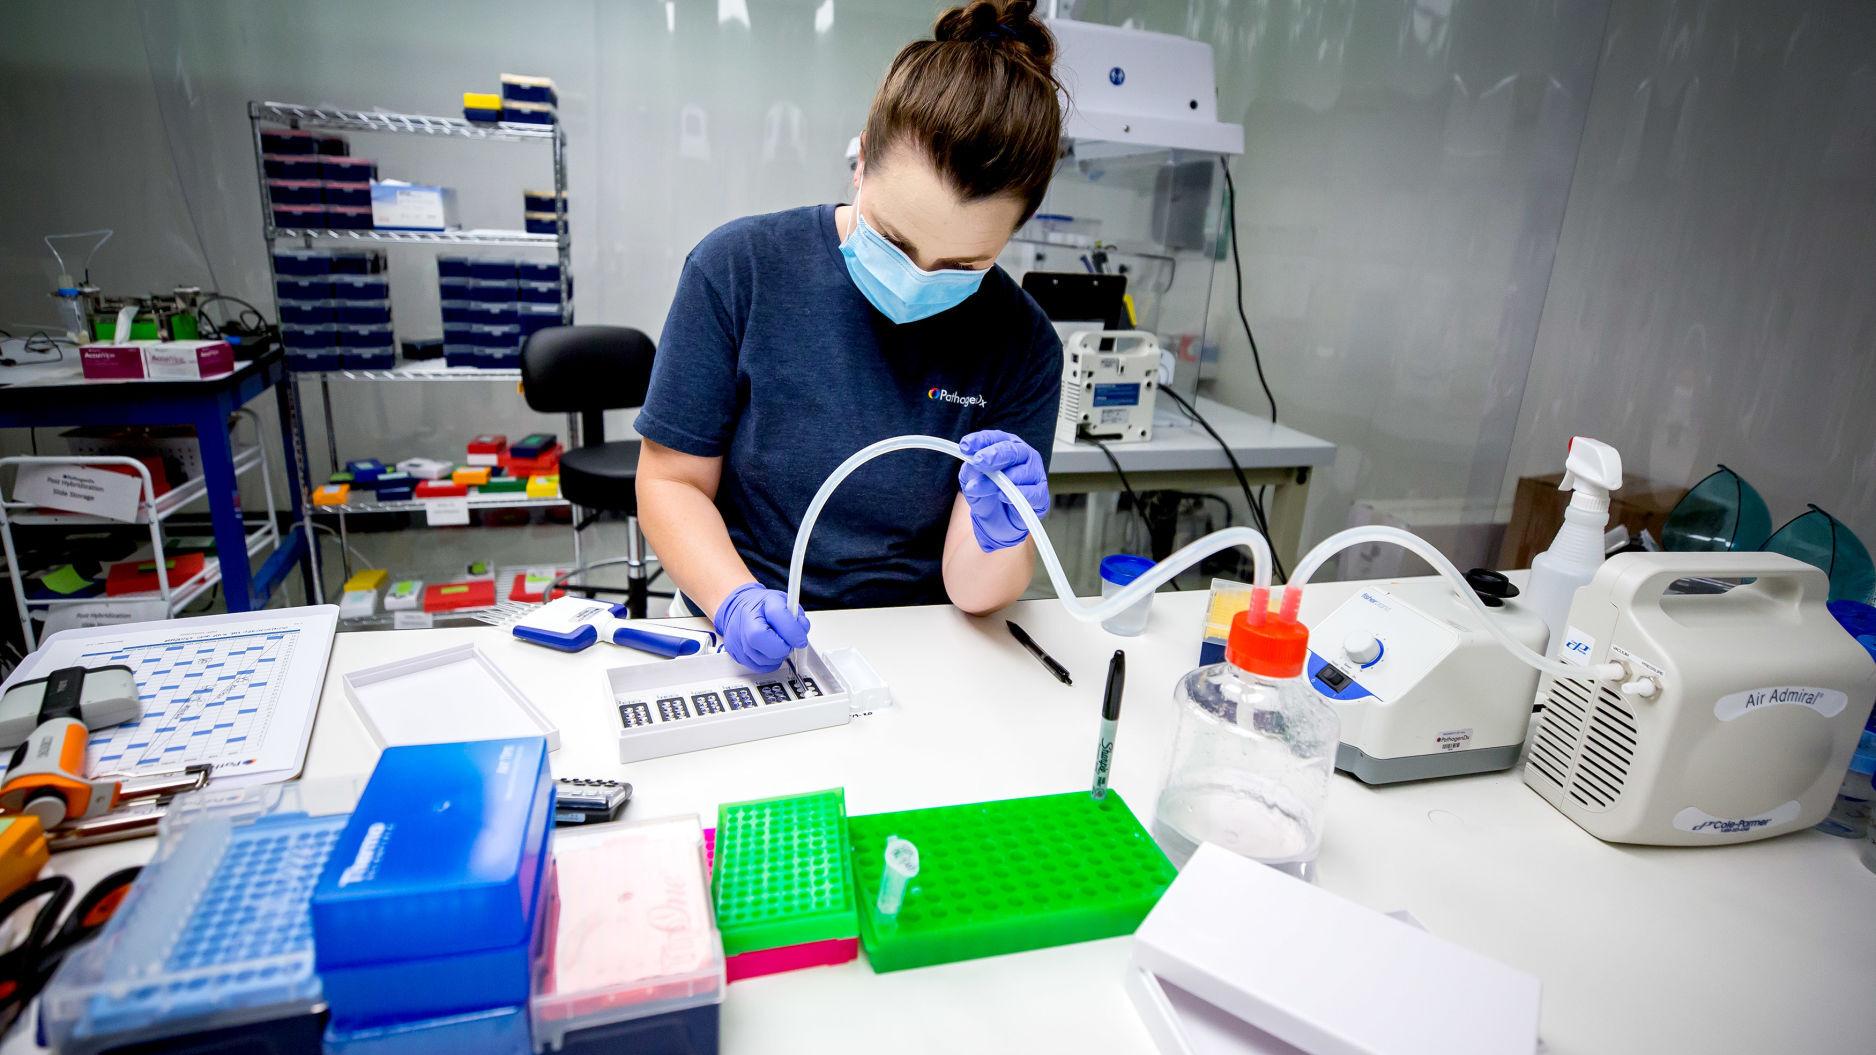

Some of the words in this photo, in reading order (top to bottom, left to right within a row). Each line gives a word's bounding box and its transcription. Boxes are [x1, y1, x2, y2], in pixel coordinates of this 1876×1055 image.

[940, 389, 987, 408] PathogeDx
[70, 491, 95, 501] Storage
[1745, 694, 1766, 708] Air
[1713, 818, 1772, 830] Cole-Parmer
